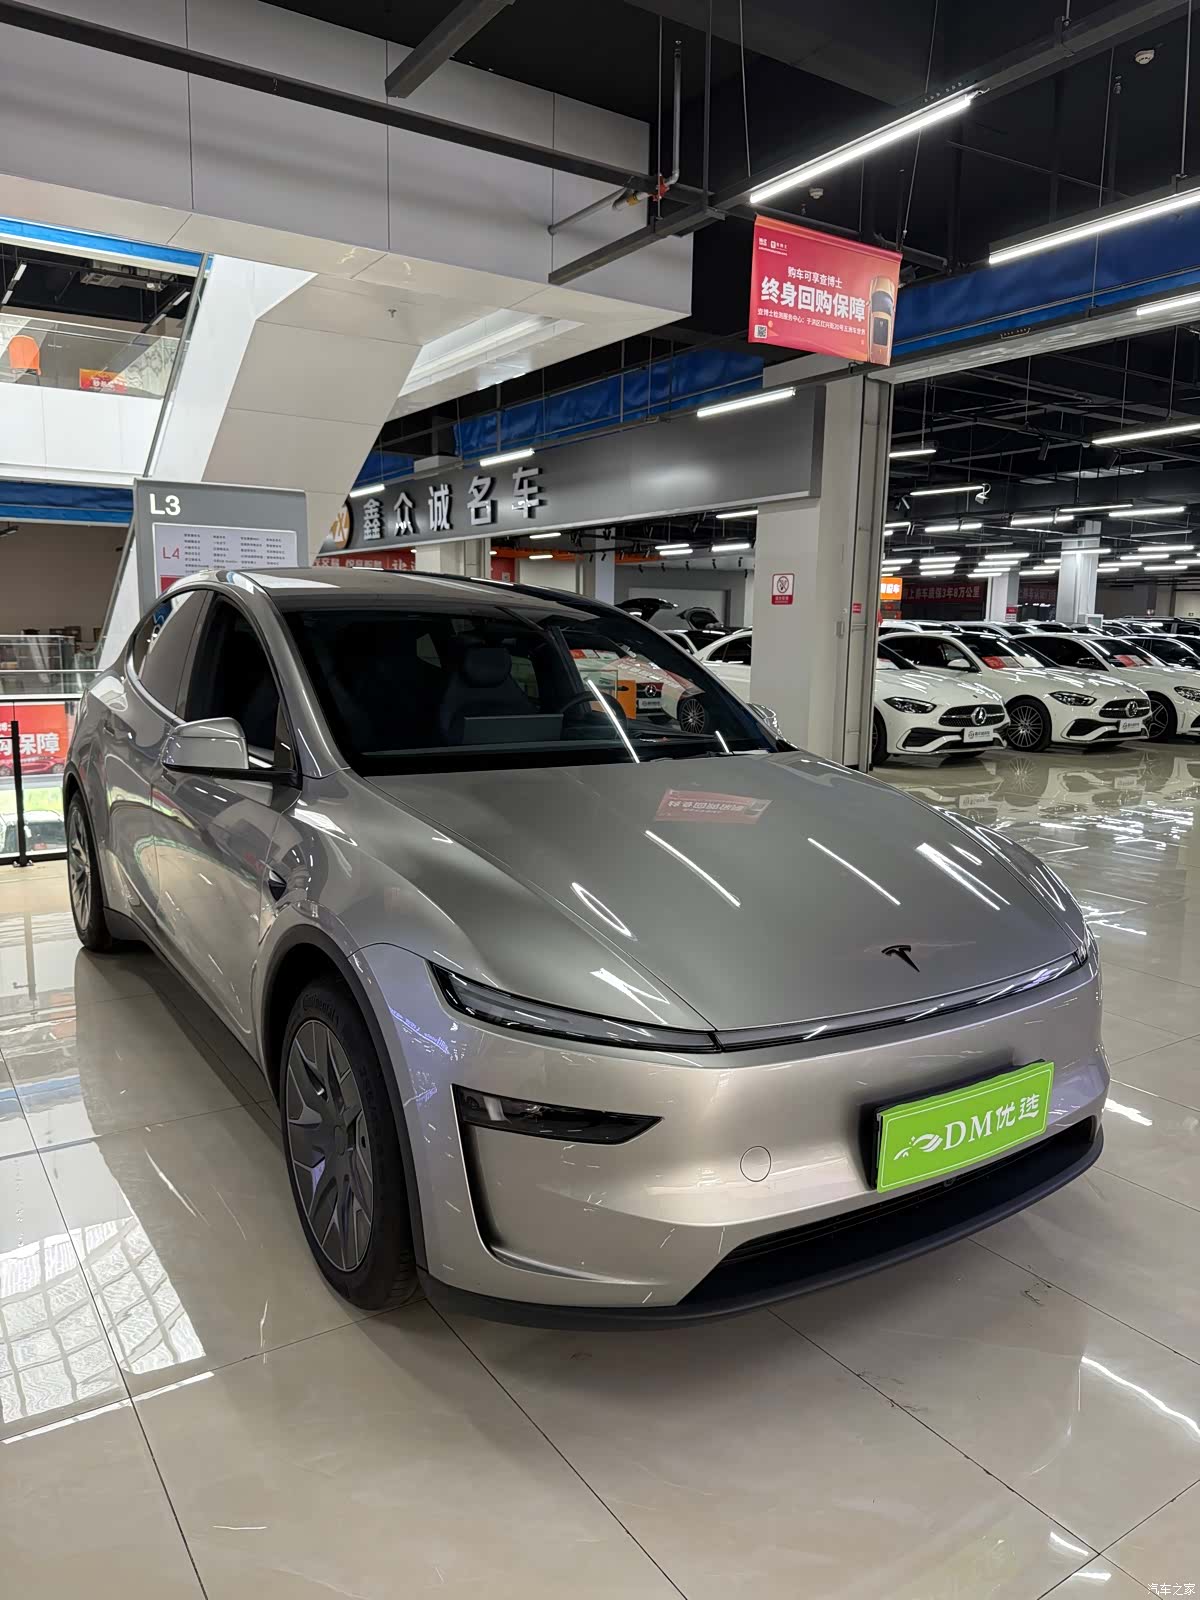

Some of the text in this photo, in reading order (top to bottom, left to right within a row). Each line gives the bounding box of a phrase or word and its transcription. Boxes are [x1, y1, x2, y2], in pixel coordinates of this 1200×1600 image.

[787, 266, 843, 289] 购车可享查博士
[760, 275, 866, 323] 终身回购保障
[149, 493, 181, 516] L3
[363, 466, 541, 541] 鑫众诚名车
[162, 546, 180, 560] L4
[943, 1093, 1041, 1151] DM优选
